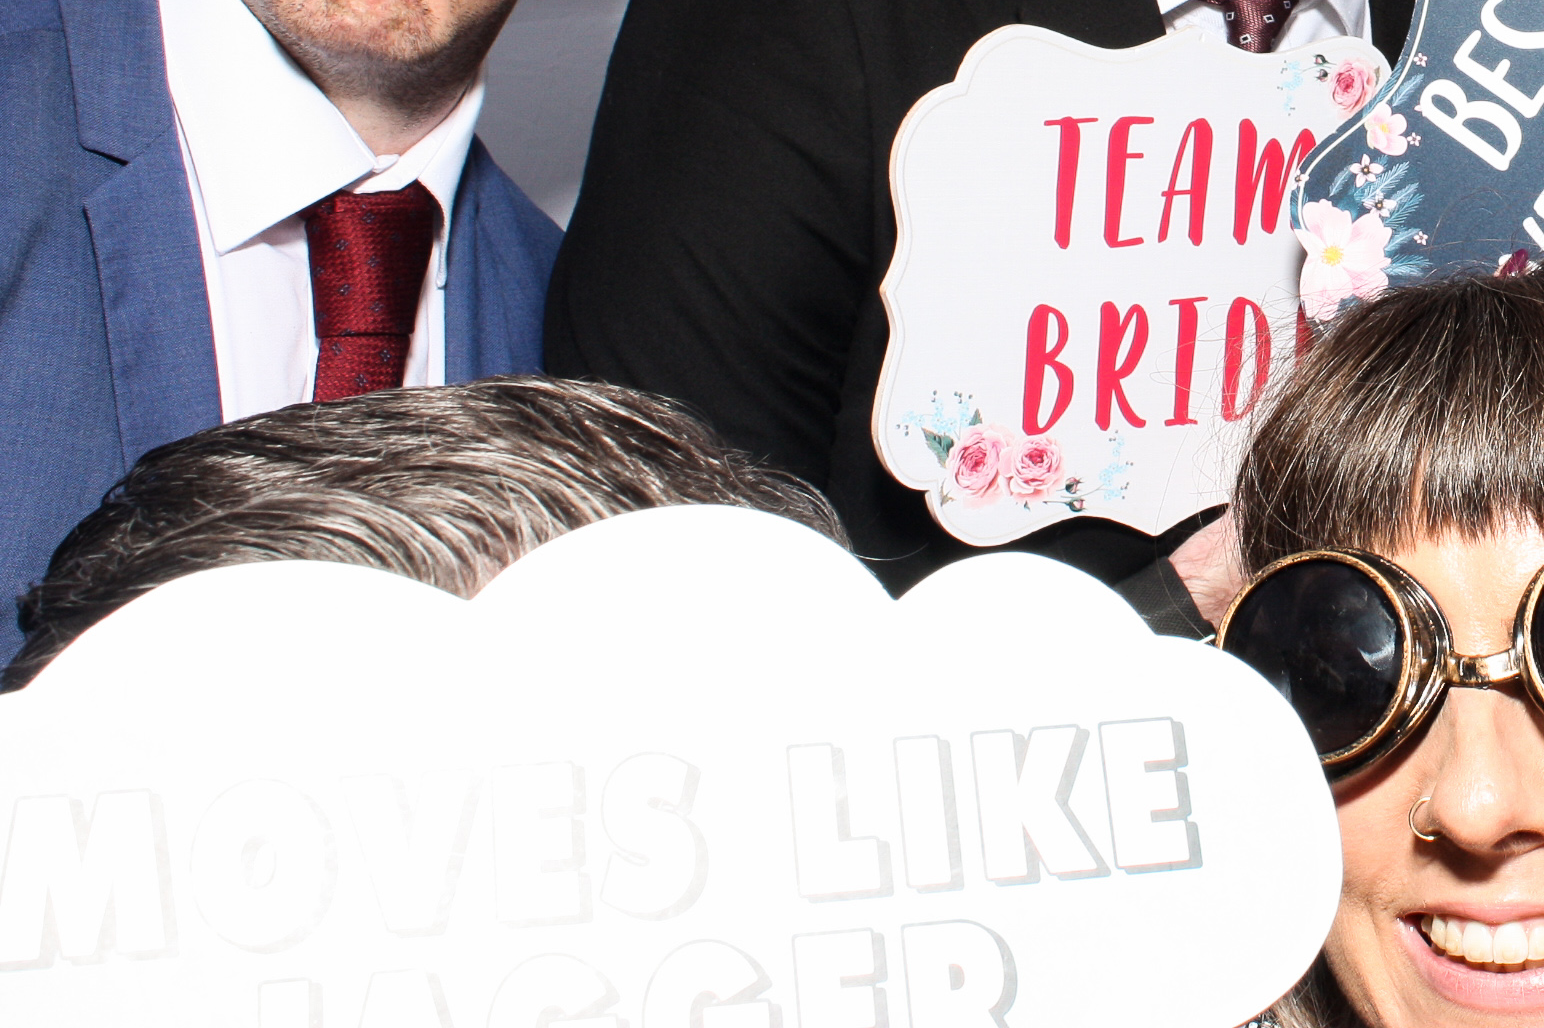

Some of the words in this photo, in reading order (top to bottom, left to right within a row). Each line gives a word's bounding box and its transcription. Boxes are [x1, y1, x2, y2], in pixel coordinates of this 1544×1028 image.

[1043, 115, 1317, 250] TEAM
[1021, 296, 1315, 436] BRID
[0, 751, 710, 971] MOVES
[785, 716, 1203, 903] LIKE
